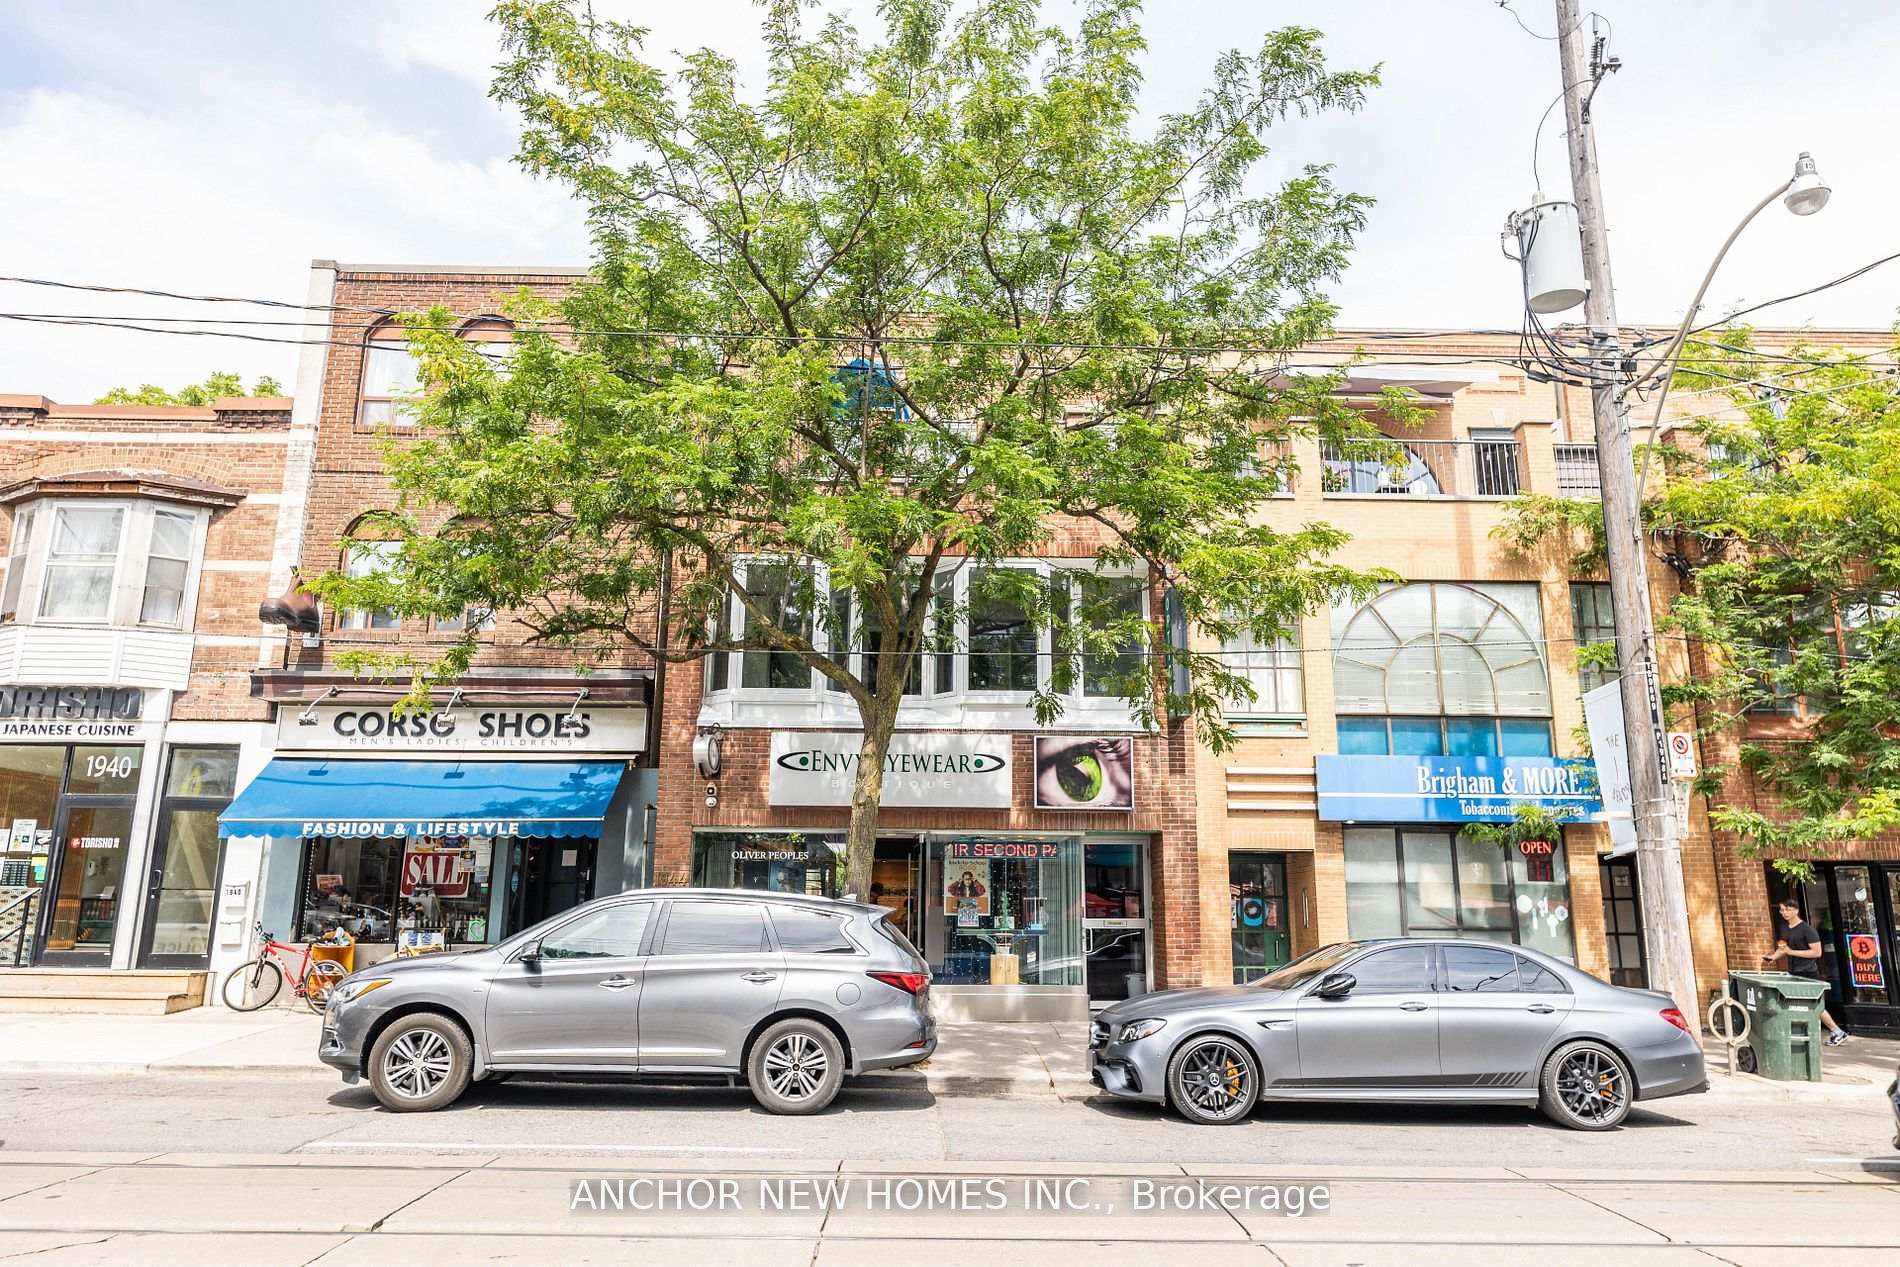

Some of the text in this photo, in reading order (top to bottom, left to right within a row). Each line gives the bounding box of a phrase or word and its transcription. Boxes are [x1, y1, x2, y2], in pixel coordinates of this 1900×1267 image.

[2, 724, 135, 736] JAPANESE CUISINE
[333, 711, 590, 738] CORSO SHOES
[86, 755, 132, 778] 1940
[882, 753, 973, 773] YEWEAR
[832, 779, 952, 790] BOTIQUE
[1416, 766, 1582, 798] Brigham & MORE
[1459, 799, 1521, 816] Tobacconis
[302, 822, 519, 835] FASHION & LIFESTYLE
[974, 844, 1037, 857] SECOND
[1520, 840, 1552, 855] OPEN
[731, 850, 809, 860] OLIVER PEOPLES
[407, 854, 465, 886] SALE
[1856, 963, 1877, 972] BUY
[1855, 973, 1880, 982] HERE
